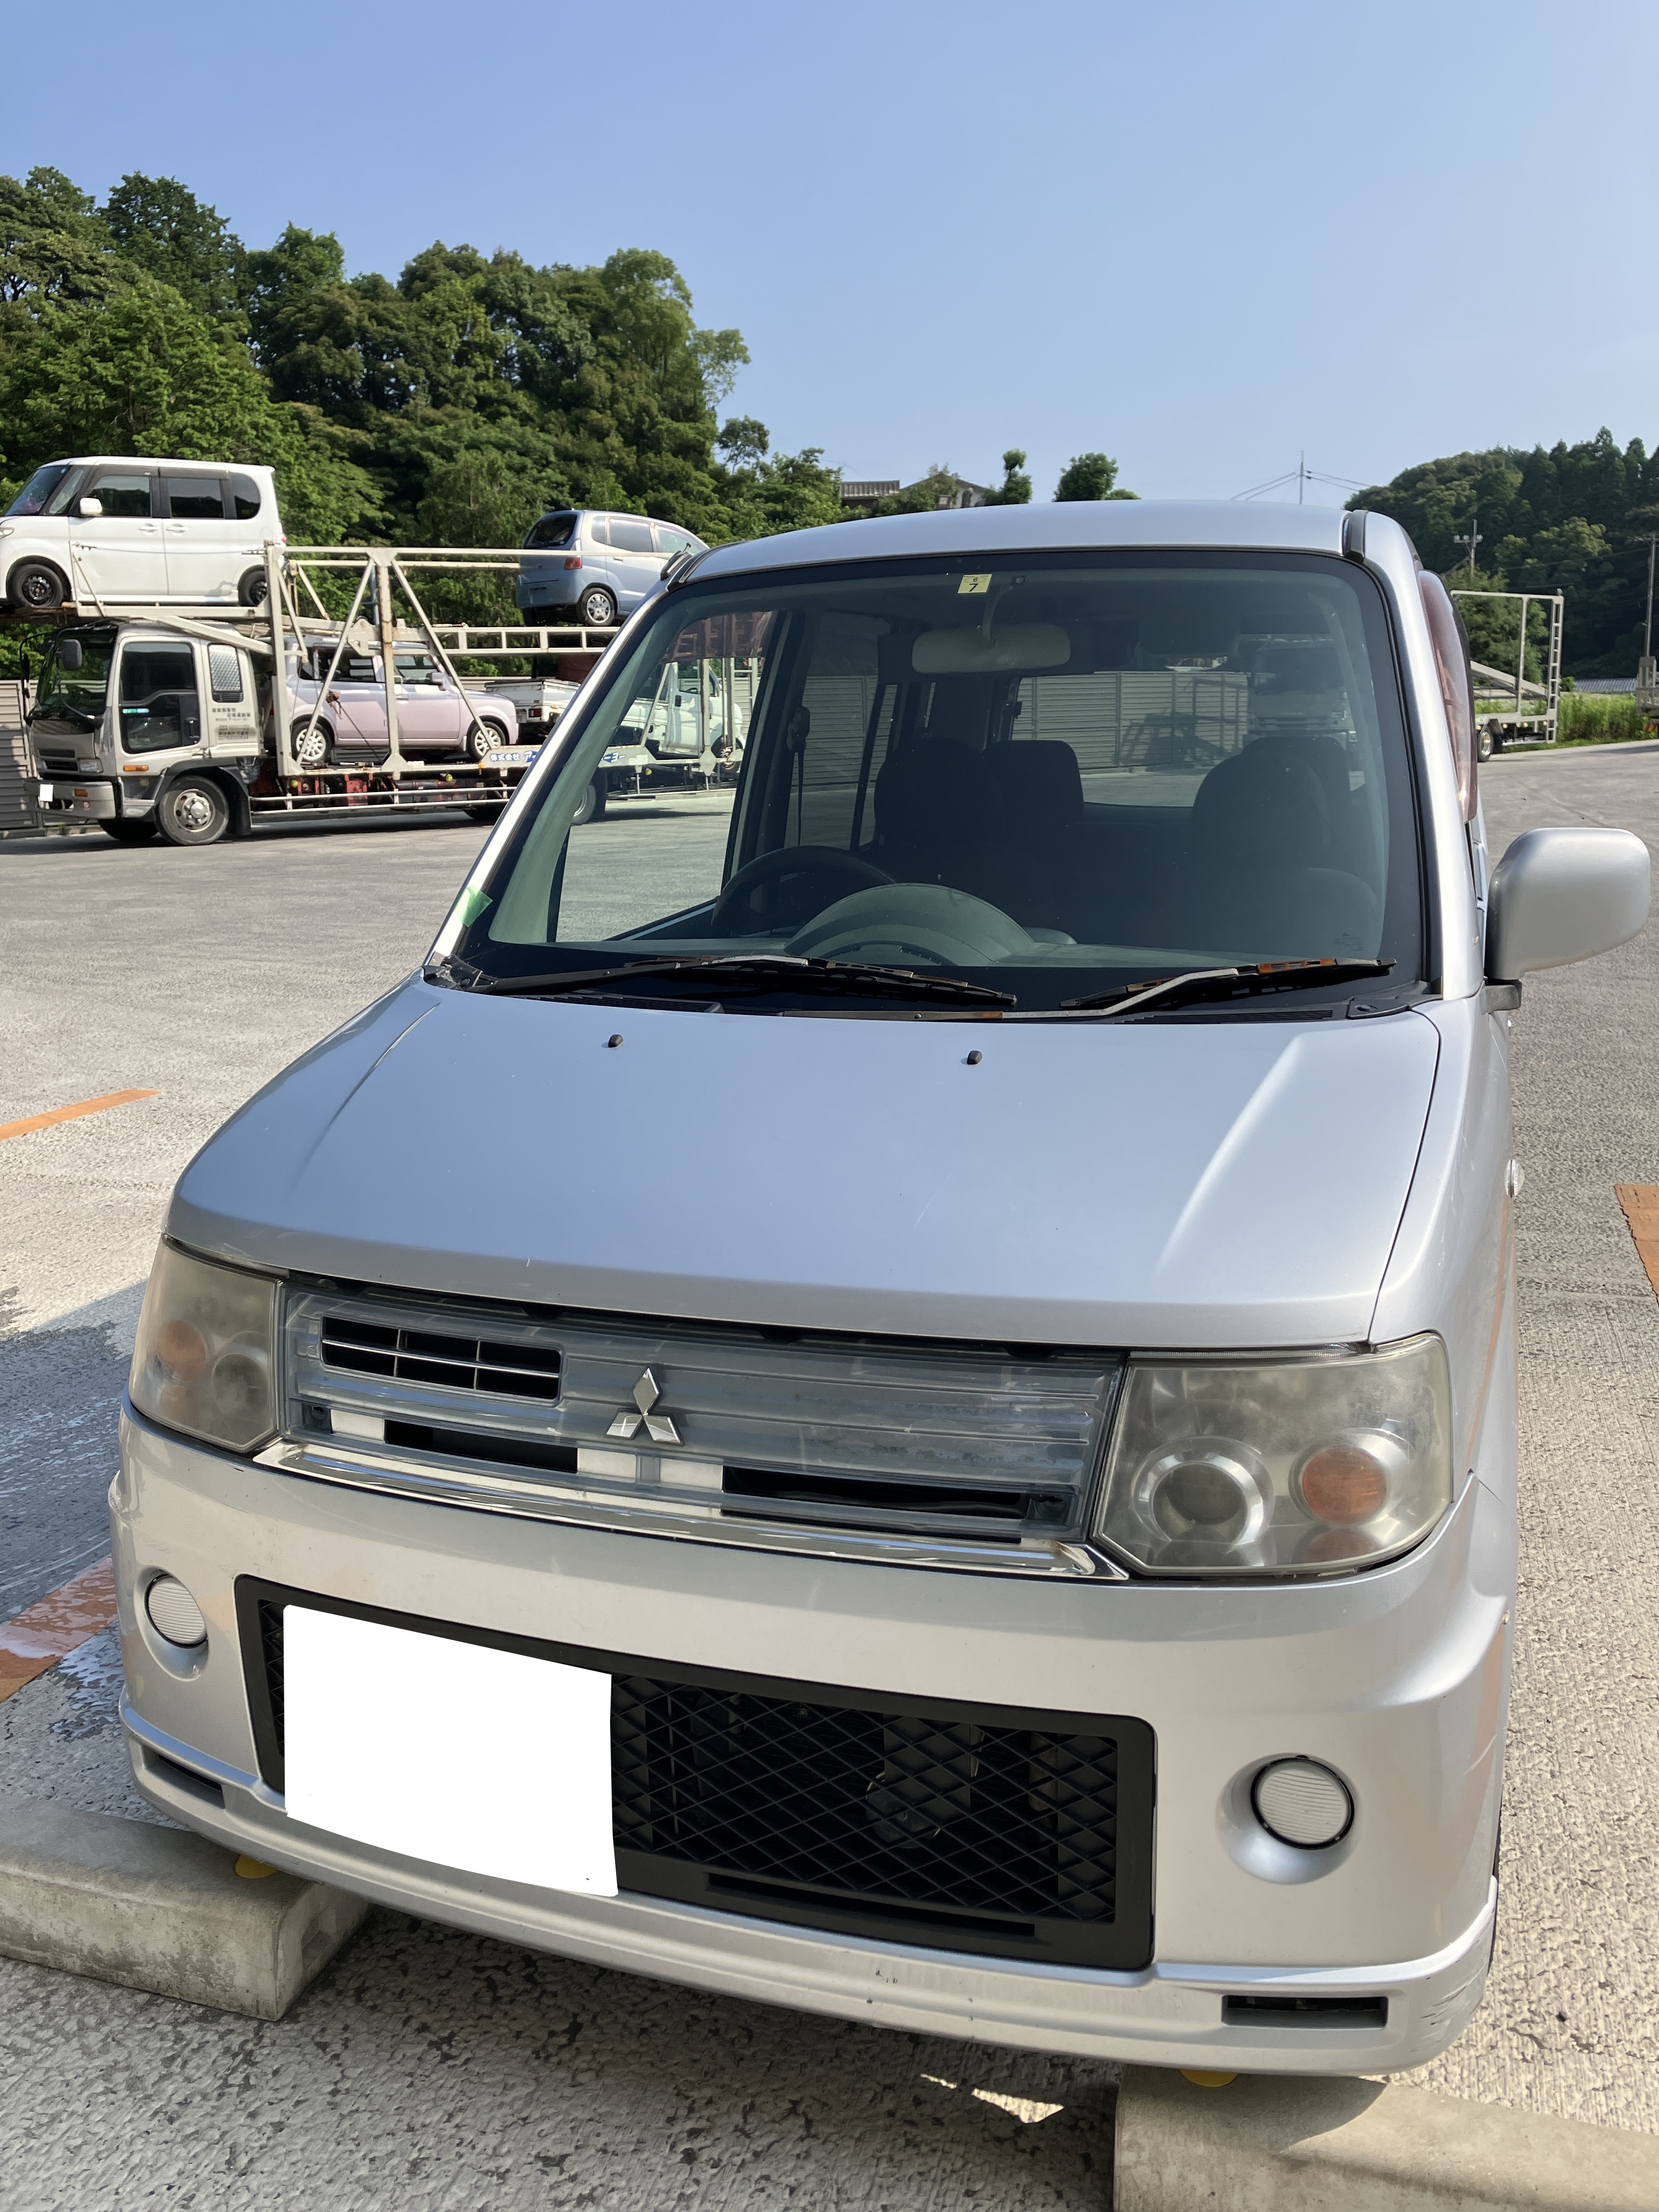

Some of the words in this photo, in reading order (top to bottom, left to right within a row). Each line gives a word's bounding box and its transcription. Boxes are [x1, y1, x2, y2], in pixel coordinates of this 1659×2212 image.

[969, 583, 979, 592] 7
[490, 753, 520, 761] 株式会社
